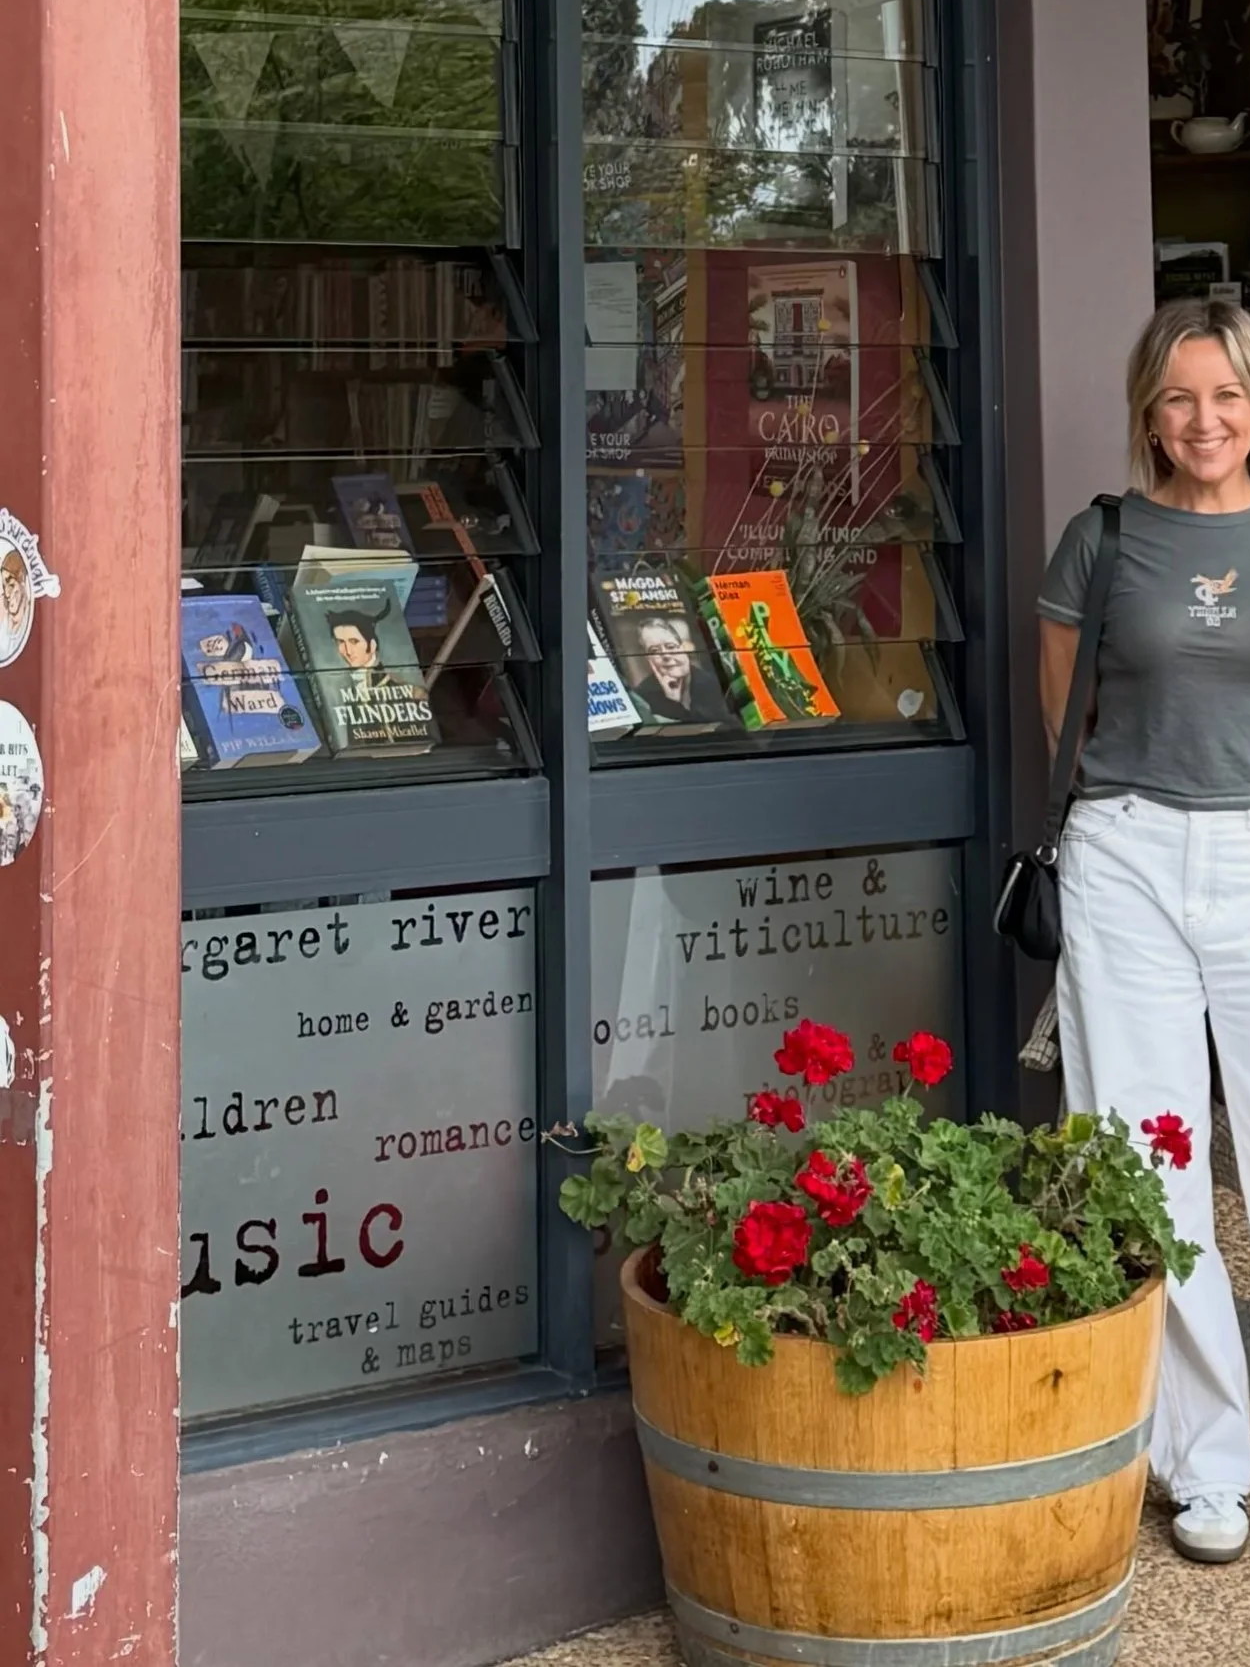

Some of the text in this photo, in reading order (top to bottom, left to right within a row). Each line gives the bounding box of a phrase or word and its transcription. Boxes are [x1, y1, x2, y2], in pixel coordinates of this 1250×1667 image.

[599, 433, 632, 447] YOUR
[758, 411, 840, 445] CAIRO
[614, 576, 666, 590] MAGDA
[229, 692, 278, 712] Ward
[339, 684, 414, 704] MATTHEW
[333, 700, 433, 726] FLINDERS
[352, 726, 387, 740] Shaun
[861, 857, 888, 898] &
[390, 901, 533, 952] river
[675, 904, 951, 964] viticulture
[297, 989, 535, 1039] home & garden
[700, 992, 800, 1033] books
[866, 1033, 887, 1064] &
[374, 1113, 536, 1163] romance
[288, 1283, 531, 1345] travel guides
[361, 1333, 472, 1375] & maps
